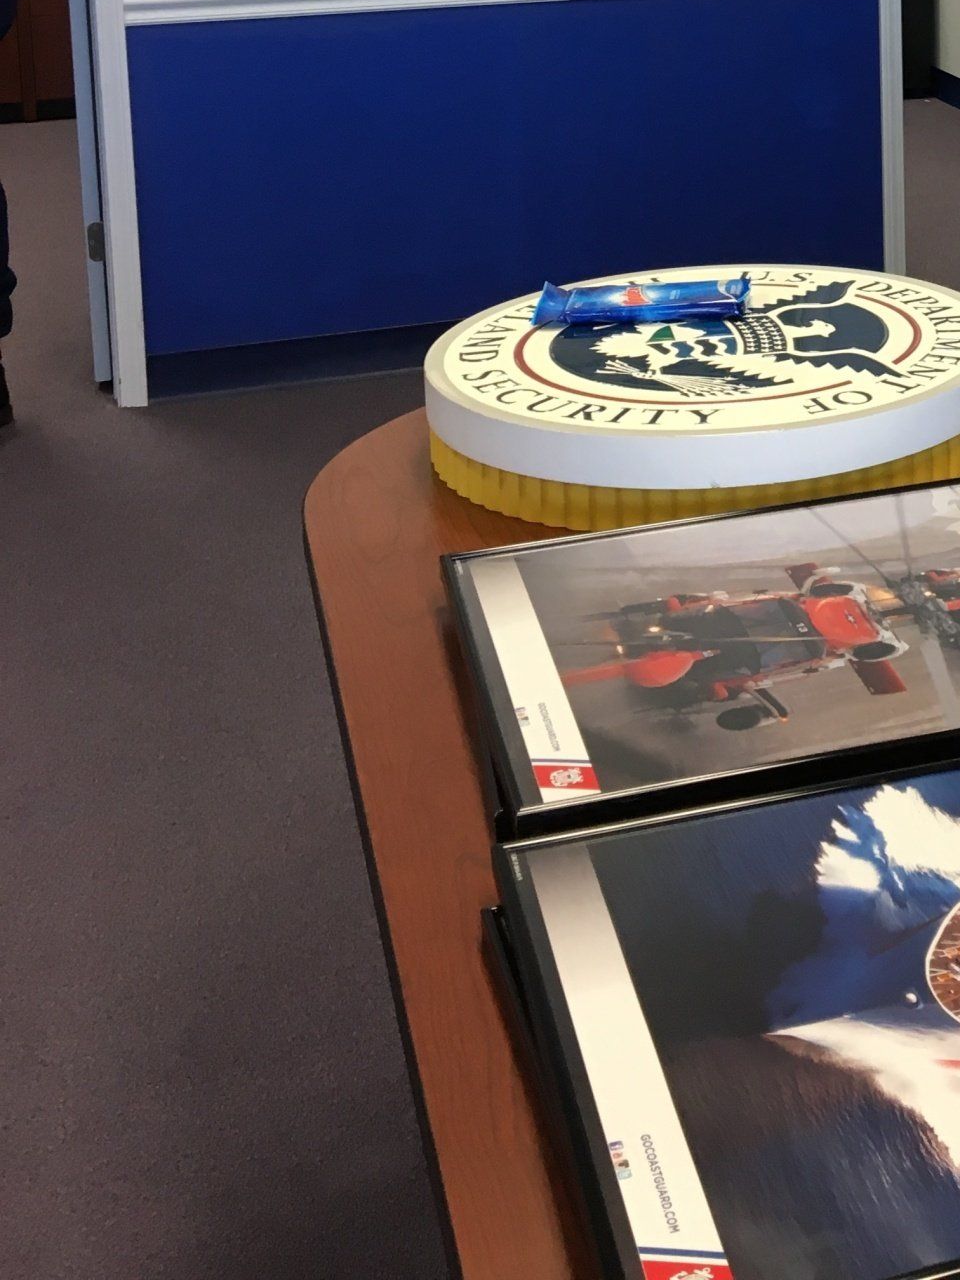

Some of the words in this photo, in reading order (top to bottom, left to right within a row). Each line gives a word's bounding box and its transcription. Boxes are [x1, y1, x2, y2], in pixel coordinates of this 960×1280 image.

[463, 369, 726, 425] SECURITY
[803, 390, 873, 415] OF
[640, 1133, 680, 1234] GOCOASTGUARD.COM
